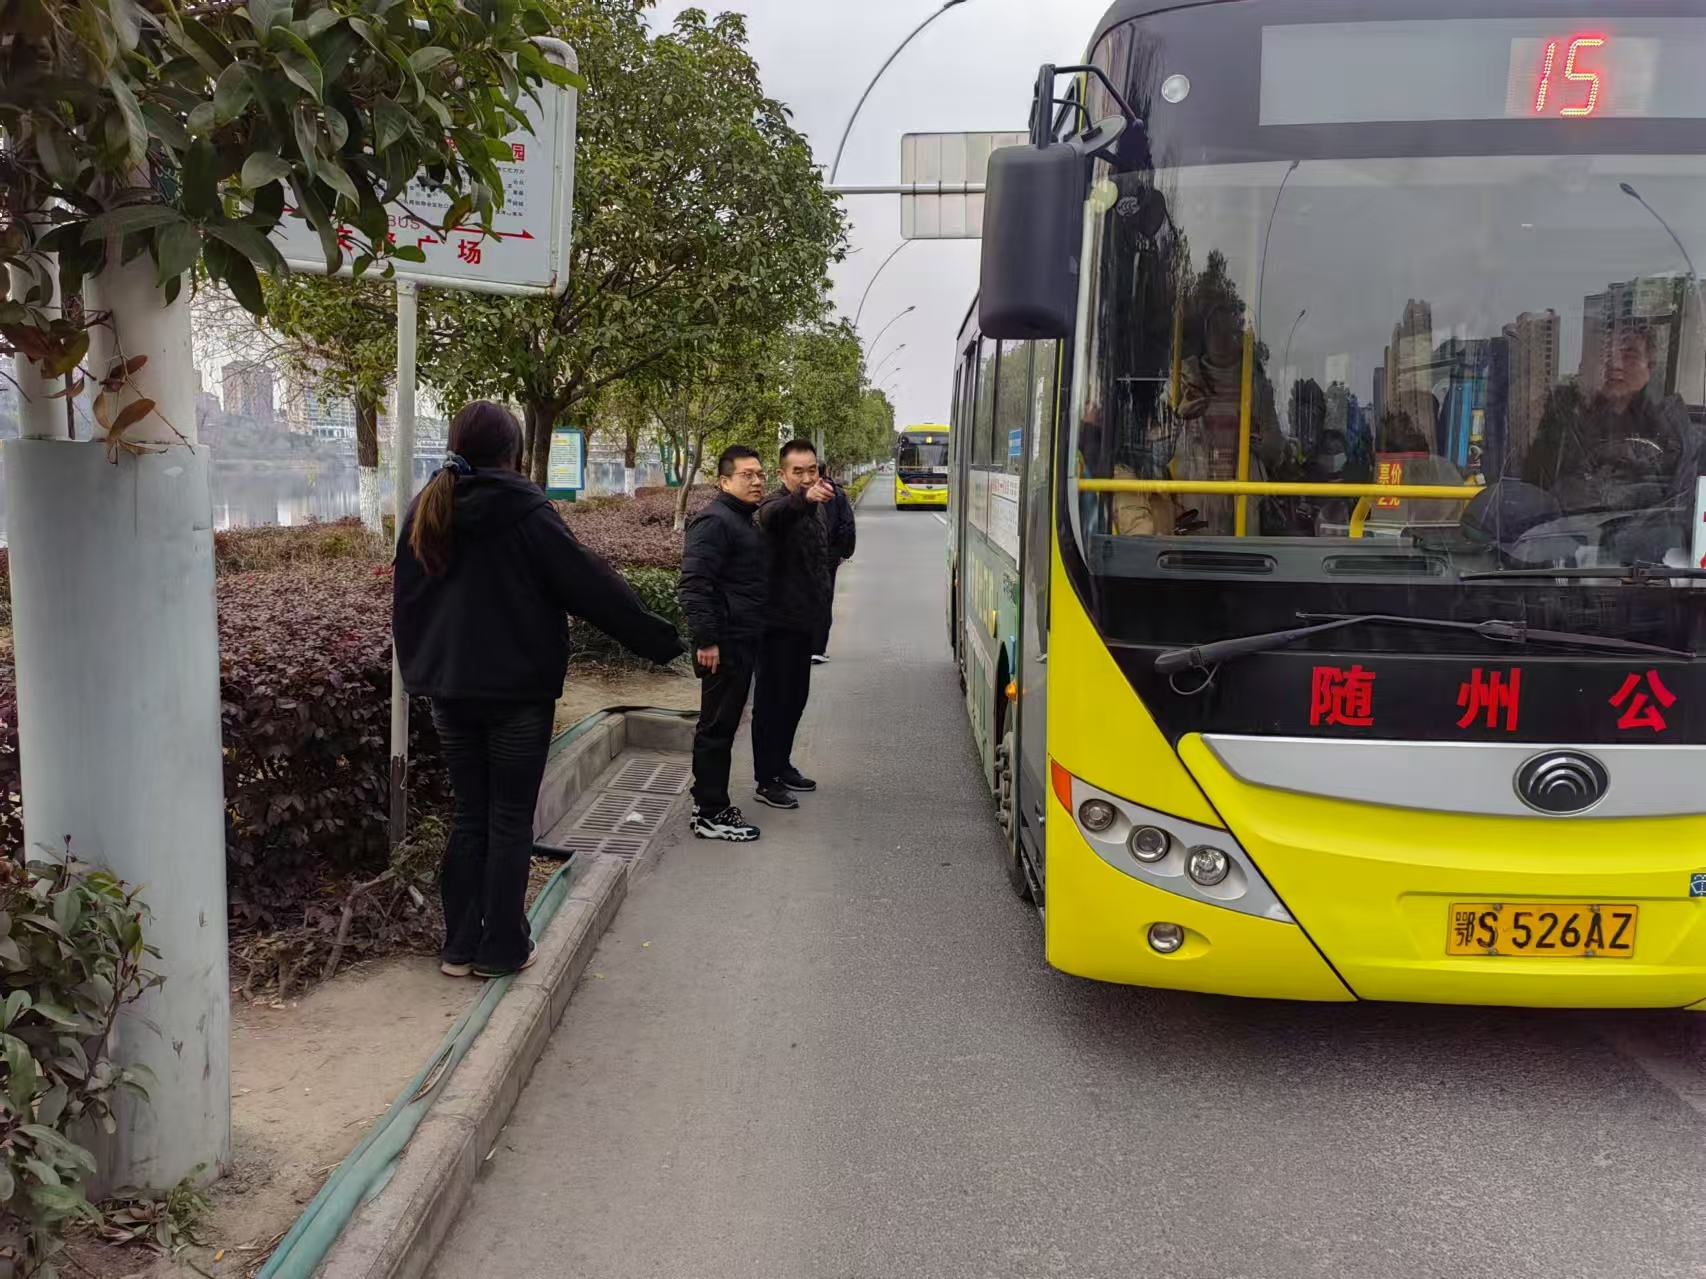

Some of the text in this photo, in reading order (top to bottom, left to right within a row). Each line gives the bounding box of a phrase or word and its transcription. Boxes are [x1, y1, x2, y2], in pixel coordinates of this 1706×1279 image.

[1536, 38, 1604, 116] 15
[387, 214, 421, 230] BUS
[1309, 664, 1678, 733] 随州公
